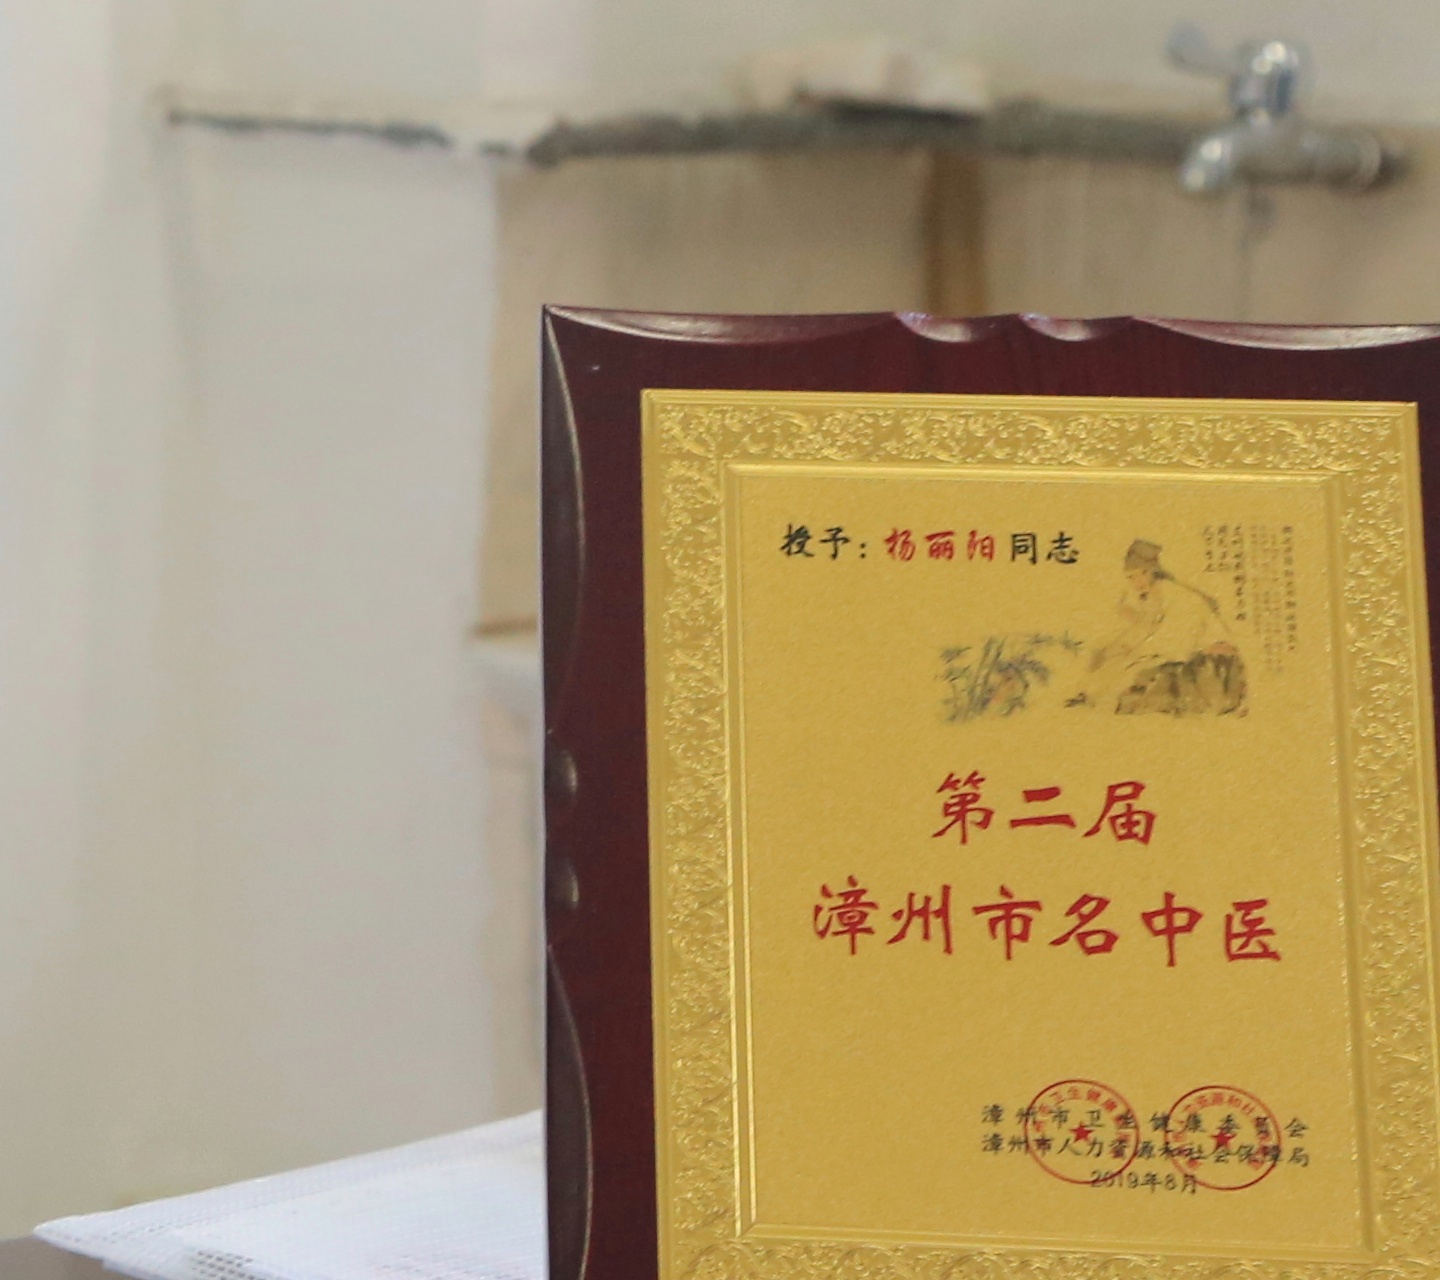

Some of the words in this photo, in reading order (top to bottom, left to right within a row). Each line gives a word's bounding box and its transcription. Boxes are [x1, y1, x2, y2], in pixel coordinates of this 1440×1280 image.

[931, 769, 1158, 846] 第二届
[812, 874, 1282, 969] 漳州市名中医
[981, 1102, 1311, 1140] 漳州市卫生健康委员会
[980, 1130, 1311, 1169] 漳州市人力资源和社会保障局
[1089, 1169, 1200, 1195] 2019年8月
